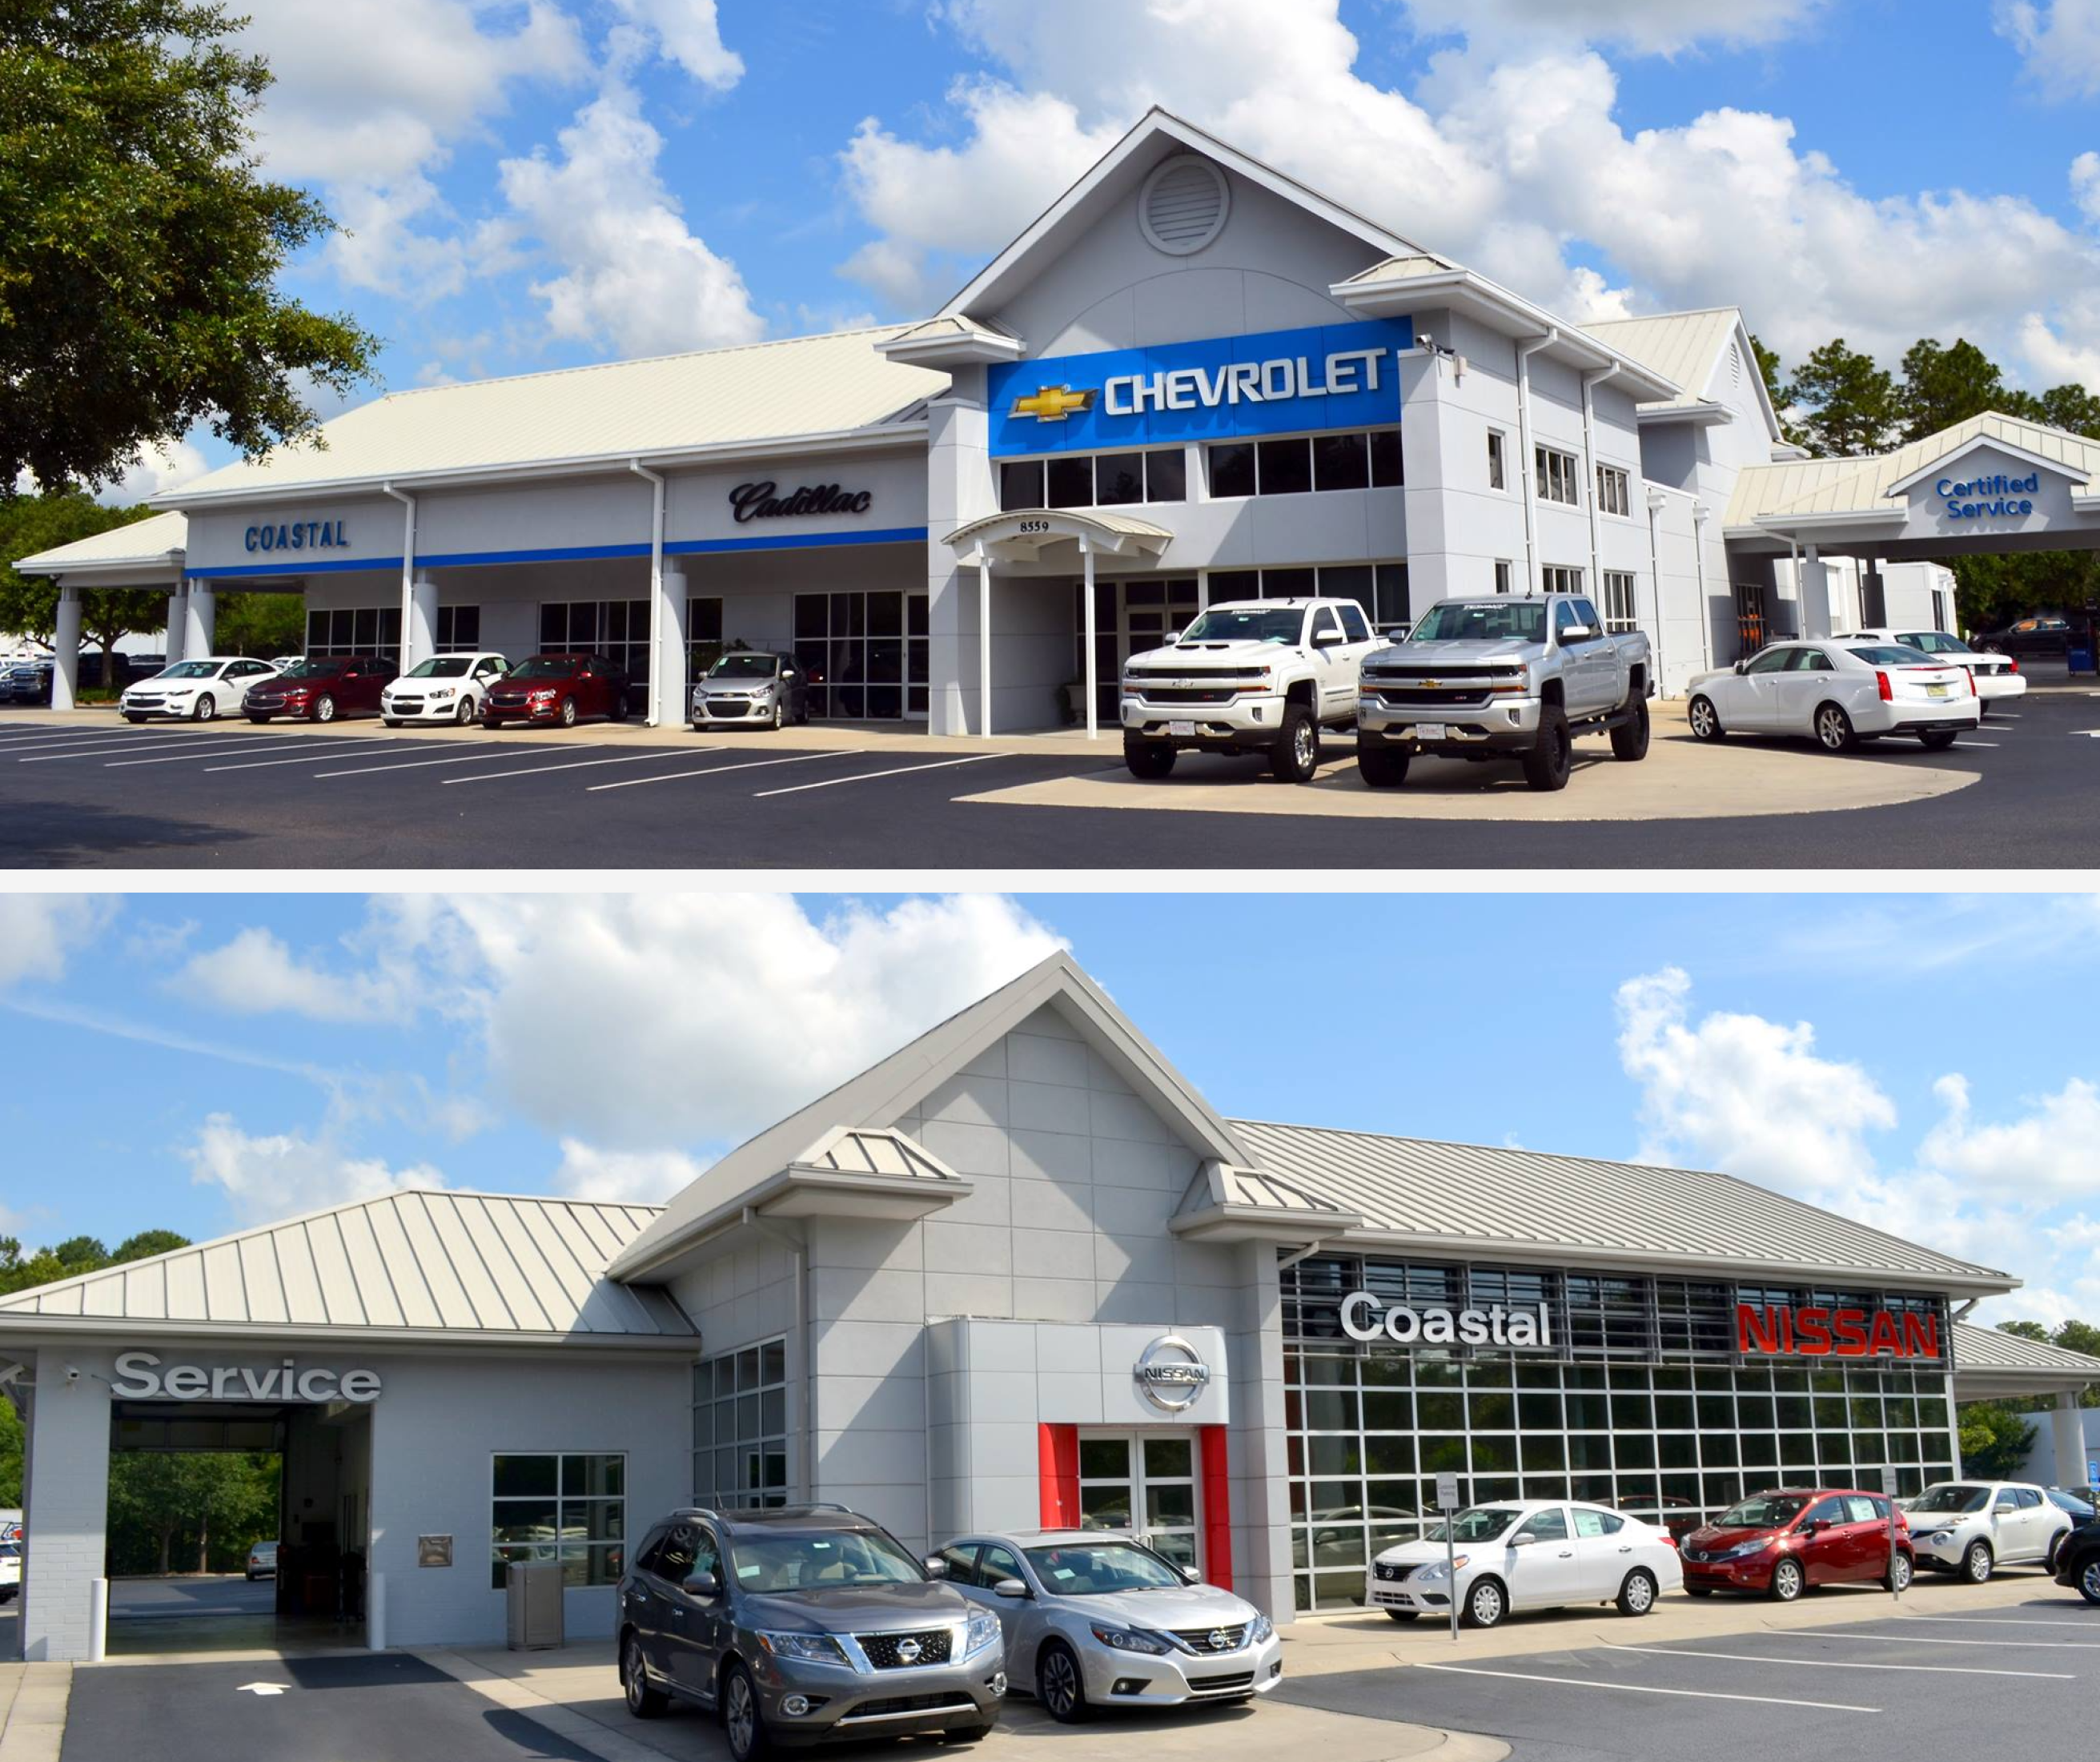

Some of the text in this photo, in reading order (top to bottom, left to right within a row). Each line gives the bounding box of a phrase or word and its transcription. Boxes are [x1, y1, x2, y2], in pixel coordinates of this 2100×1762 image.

[1104, 347, 1387, 415] CHEVROLET
[729, 481, 871, 523] Cadillac
[1937, 472, 2039, 497] Certified
[1945, 496, 2033, 519] Service
[244, 520, 349, 552] COASTAL
[1020, 520, 1049, 533] 8559
[1339, 1291, 1551, 1347] Coastal
[1737, 1302, 1939, 1359] NISSAN
[110, 1351, 382, 1403] Service
[1144, 1367, 1206, 1381] NISSAN
